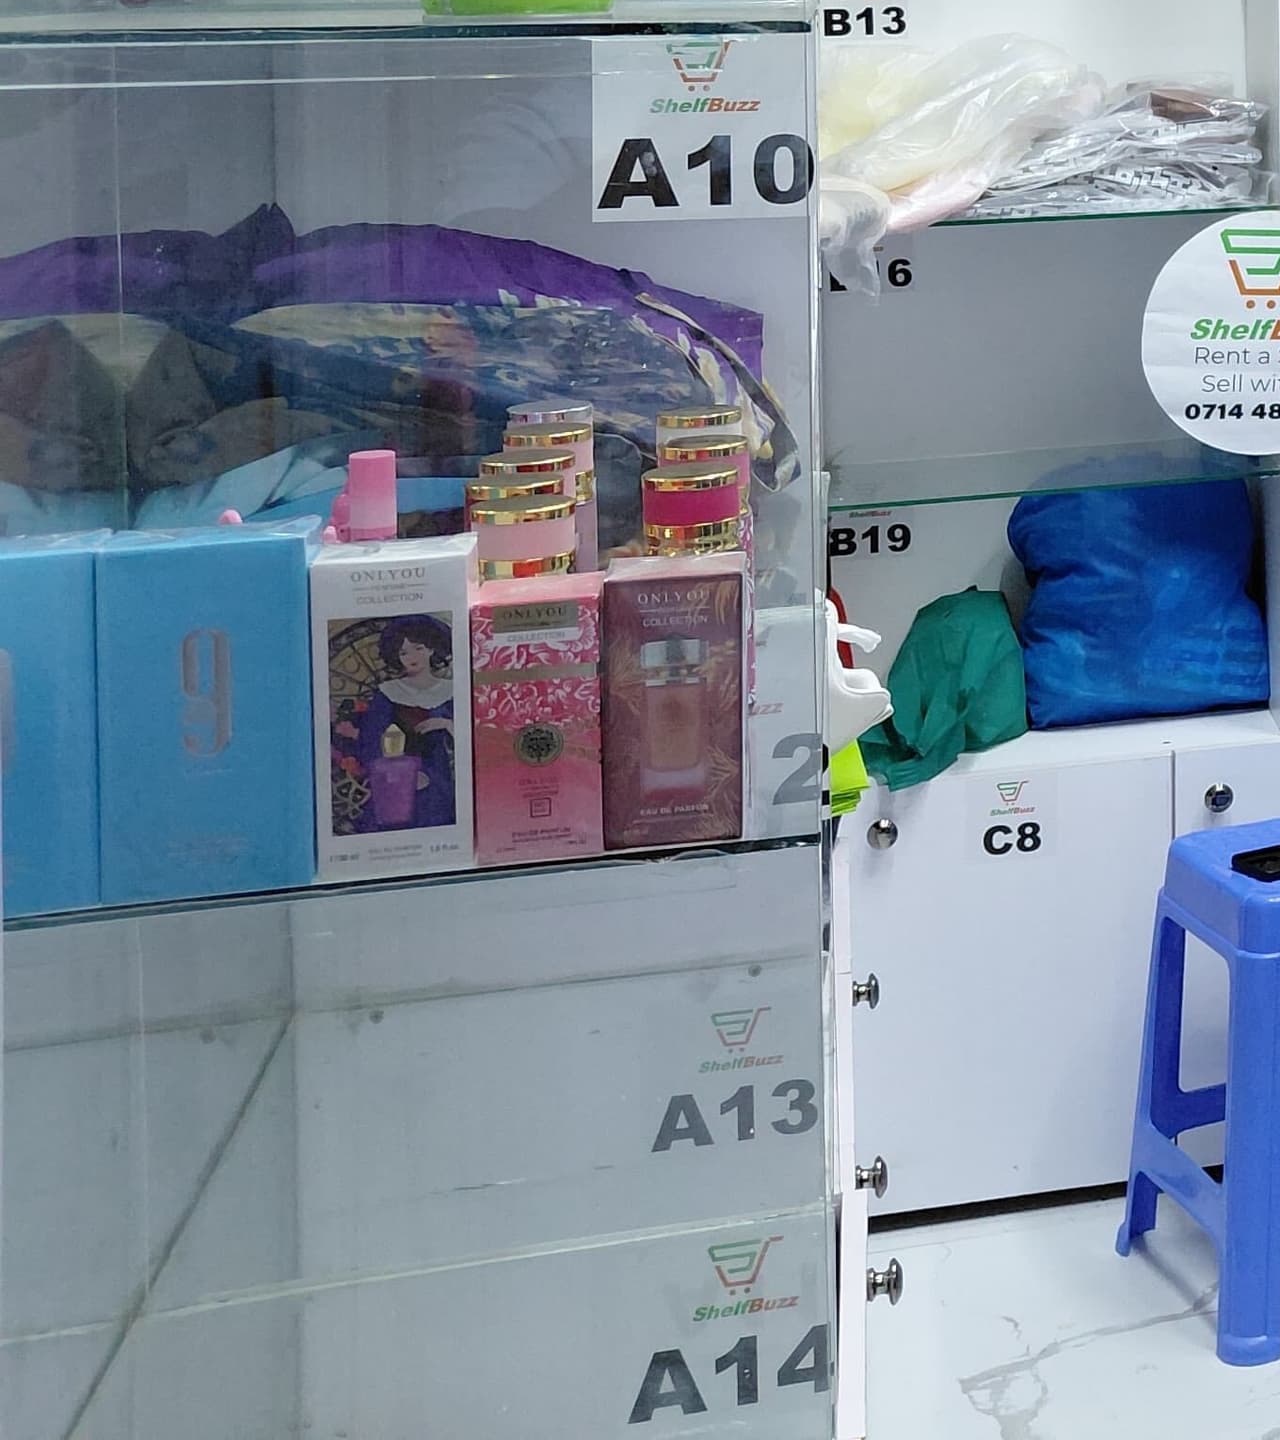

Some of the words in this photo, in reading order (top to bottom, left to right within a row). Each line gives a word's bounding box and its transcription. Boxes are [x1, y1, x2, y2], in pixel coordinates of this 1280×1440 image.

[823, 6, 907, 37] B13
[649, 97, 761, 114] ShelfBuzz
[597, 134, 815, 209] A10
[1194, 346, 1250, 365] Rent
[1257, 351, 1271, 365] a
[1202, 374, 1243, 393] Sell
[1184, 402, 1244, 421] 0714
[828, 524, 912, 558] B19
[356, 592, 423, 605] COLLECTION
[643, 615, 708, 627] COLLECTION
[983, 822, 1042, 856] C8
[698, 1054, 784, 1074] ShelfBuzz
[651, 1079, 818, 1152] A13
[692, 1295, 799, 1323] ShelfBuzz
[628, 1323, 837, 1425] A14
